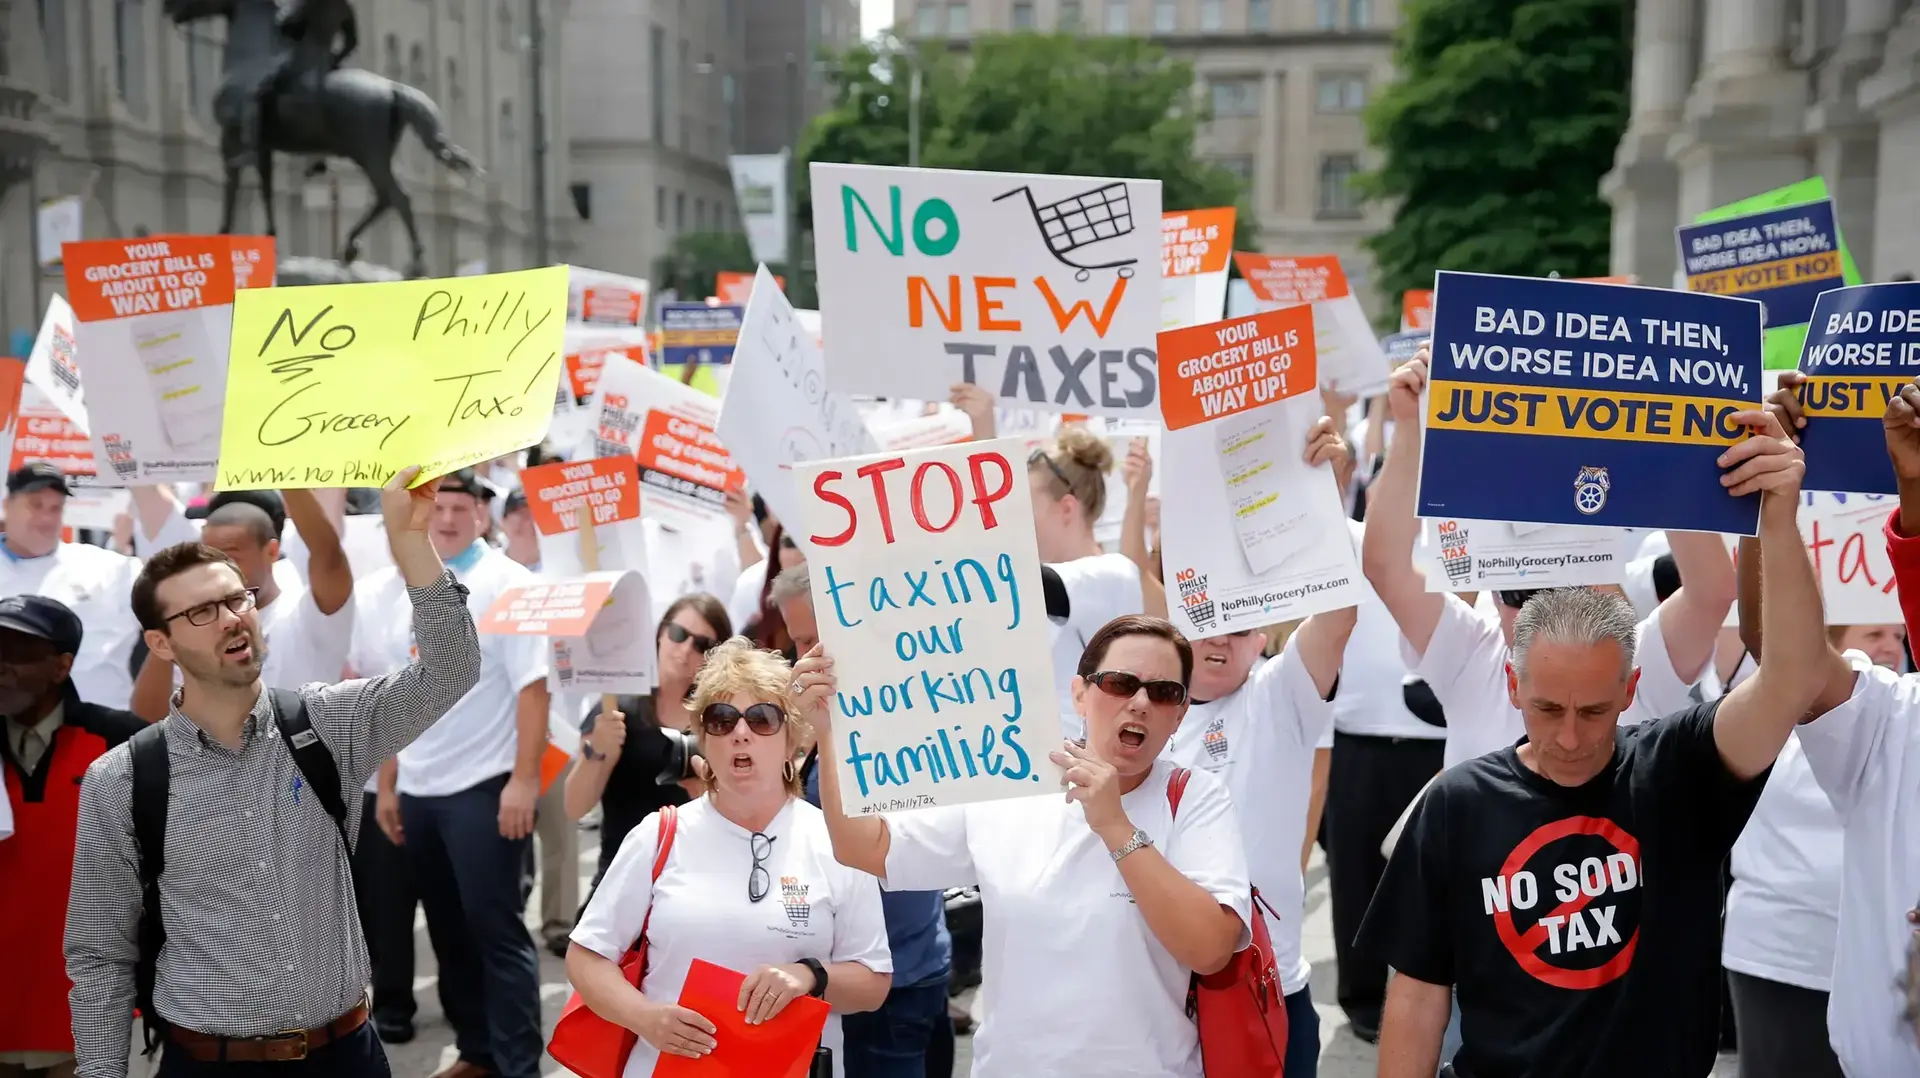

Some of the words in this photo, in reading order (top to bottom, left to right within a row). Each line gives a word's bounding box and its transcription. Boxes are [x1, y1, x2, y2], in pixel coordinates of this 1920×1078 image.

[124, 241, 170, 261] YOUR
[1686, 249, 1738, 273] WORSE
[1738, 242, 1780, 264] IDEA
[1780, 233, 1831, 256] NOW,
[1692, 234, 1723, 254] BAD
[1723, 226, 1763, 249] IDEA
[1763, 217, 1816, 240] THEN,
[84, 259, 161, 282] GROCERY
[164, 255, 198, 274] BILL
[198, 252, 214, 269] IS
[101, 277, 159, 298] ABOUT
[159, 274, 180, 290] TO
[182, 270, 207, 287] GO
[1733, 264, 1789, 288] VOTE
[1795, 257, 1837, 277] NO!
[110, 291, 161, 317] WAY
[165, 286, 203, 310] UP!
[907, 275, 1128, 338] NEW
[257, 305, 356, 358] No
[413, 290, 552, 361] Philly
[1215, 320, 1259, 347] YOUR
[1474, 306, 1546, 336] BAD
[1555, 311, 1632, 343] IDEA
[1641, 318, 1729, 356] THEN,
[1825, 310, 1874, 336] BAD
[1879, 309, 1920, 333] IDE
[1177, 343, 1249, 379] GROCERY
[1252, 334, 1283, 358] BILL
[1284, 329, 1299, 348] IS
[1449, 342, 1573, 377] WORSE
[1582, 351, 1660, 382] IDEA
[1669, 357, 1749, 395] NOW,
[1807, 342, 1893, 367] WORSE
[1899, 342, 1920, 366] ID
[943, 342, 1159, 409] TAXES
[1192, 366, 1244, 397] ABOUT
[1245, 360, 1267, 380] TO
[1269, 353, 1292, 373] GO
[257, 382, 411, 450] Grocery
[434, 351, 556, 428] Tax!
[1200, 384, 1248, 418] WAY
[1253, 373, 1288, 402] UP!
[1436, 388, 1547, 427] JUST
[1556, 395, 1673, 436] VOTE
[809, 452, 1014, 547] STOP
[1438, 520, 1457, 534] NO
[1440, 529, 1469, 543] PHILLY
[1442, 545, 1468, 560] TAX
[1478, 553, 1613, 570] NoPhillyGroceryTax.com
[825, 553, 1021, 631] taxing
[1176, 568, 1195, 583] NO
[1179, 574, 1208, 592] PHILLY
[1182, 590, 1209, 608] TAX
[1221, 576, 1350, 612] NoPhillyGroceryTax.com
[895, 617, 963, 662] our
[837, 667, 1023, 723] working
[846, 724, 1040, 798] families.
[780, 876, 798, 885] NO
[782, 884, 809, 892] PHILLY
[1481, 871, 1539, 916] NO
[1553, 852, 1644, 903] SOD
[783, 895, 807, 904] TAX
[1538, 905, 1622, 955] TAX
